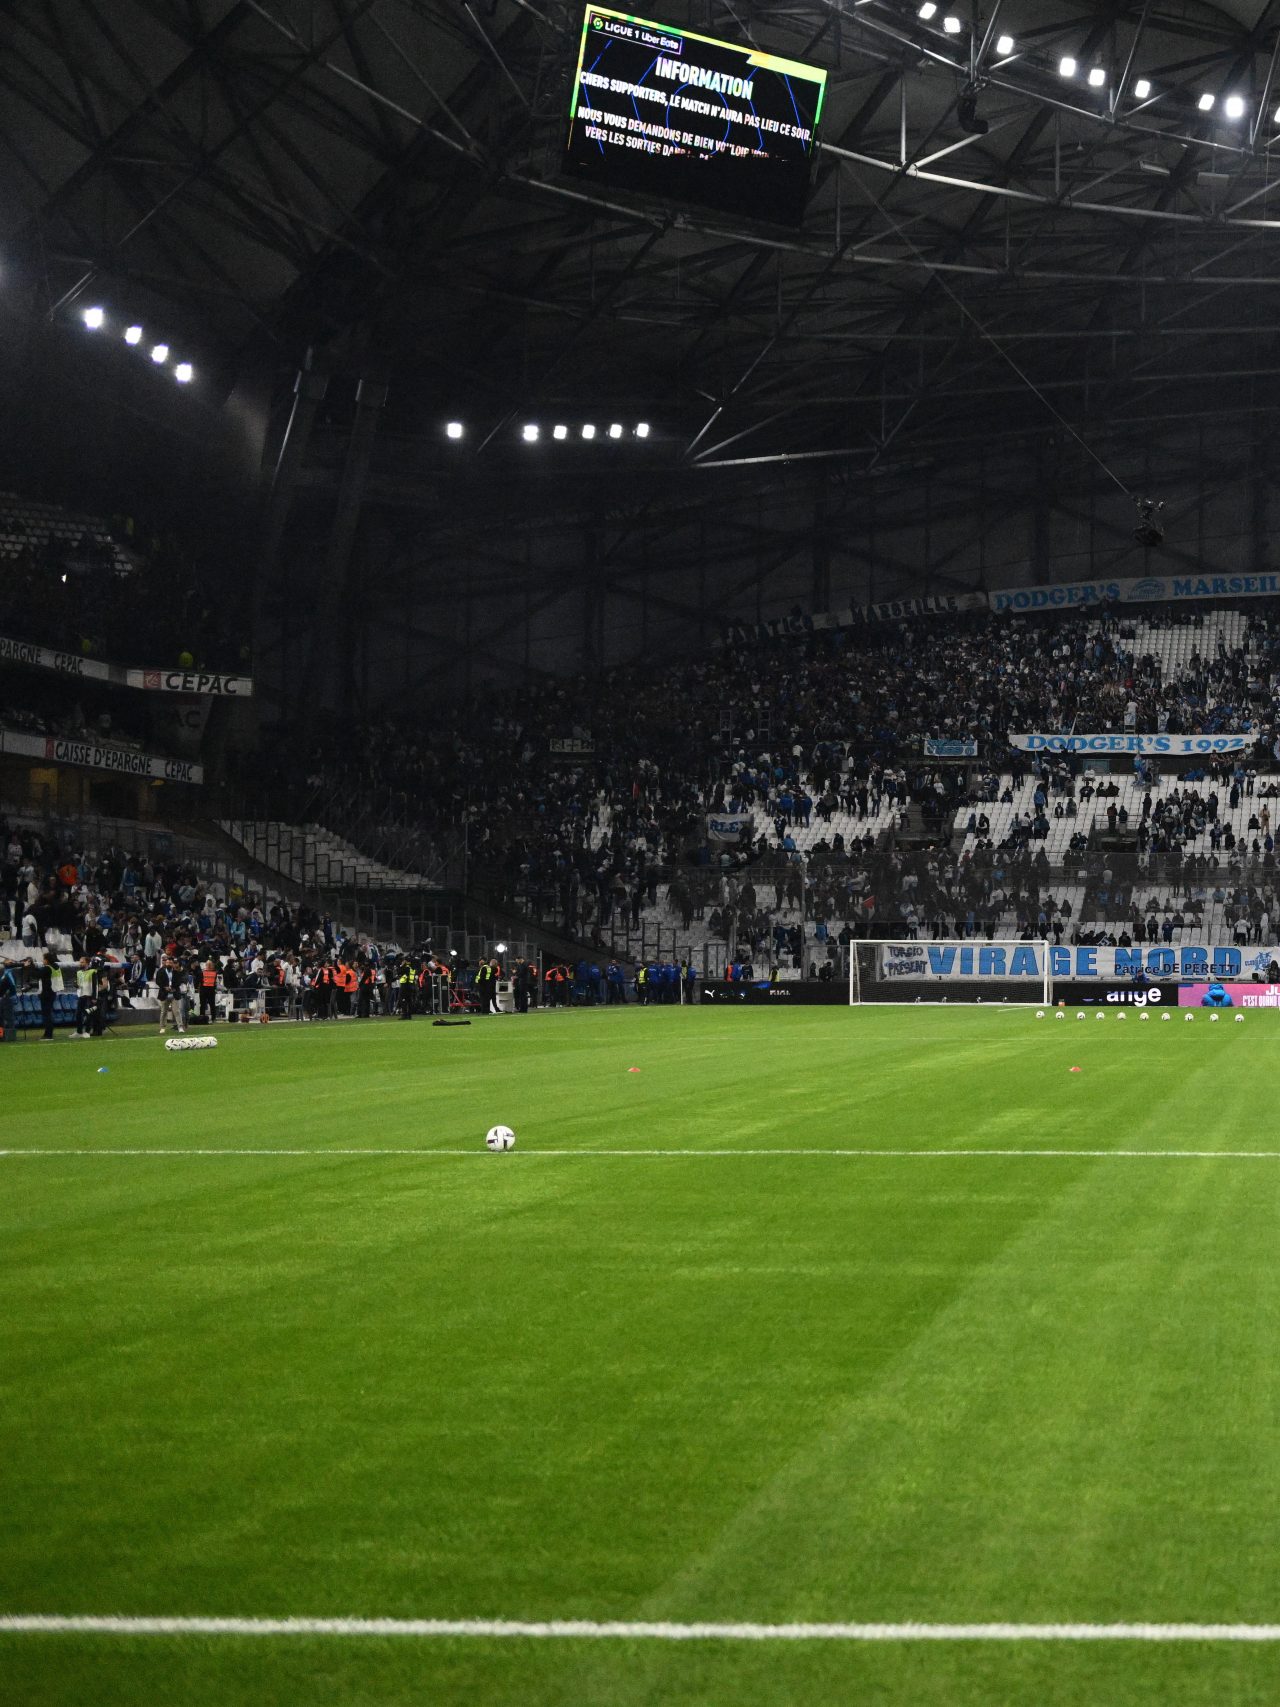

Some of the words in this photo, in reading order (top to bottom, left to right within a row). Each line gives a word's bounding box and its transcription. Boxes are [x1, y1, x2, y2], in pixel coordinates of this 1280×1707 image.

[604, 21, 633, 37] LIGUE
[641, 32, 660, 44] Uber
[660, 37, 679, 49] Eats
[655, 56, 754, 100] INFORMATION
[580, 71, 609, 91] CHERS
[610, 78, 669, 106] SUPPORTERS,
[669, 94, 680, 108] LE
[681, 98, 710, 116] MATCH
[711, 105, 743, 124] N'AURA
[744, 113, 761, 128] PAS
[761, 118, 780, 133] LIEU
[780, 123, 790, 136] CE
[577, 106, 603, 122] NOUS
[603, 112, 628, 129] VOUS
[627, 118, 681, 142] DEMANDONS
[682, 131, 693, 145] DE
[694, 133, 714, 150] BIEN
[585, 125, 608, 141] VERS
[608, 131, 625, 146] LES
[626, 137, 662, 154] SORTIES
[0, 638, 41, 664] PARGNE
[165, 672, 237, 694] CEPAC
[1026, 736, 1171, 751] DODGER'S
[1182, 737, 1245, 751] 1992
[55, 742, 91, 765] CAISSE
[94, 749, 152, 775] D'EPARGNE
[165, 759, 193, 781] CEPAC
[927, 946, 1098, 977] VIRAGE
[1114, 946, 1242, 977] NORD
[1163, 963, 1180, 974] DE
[1184, 963, 1239, 975] PERETTI
